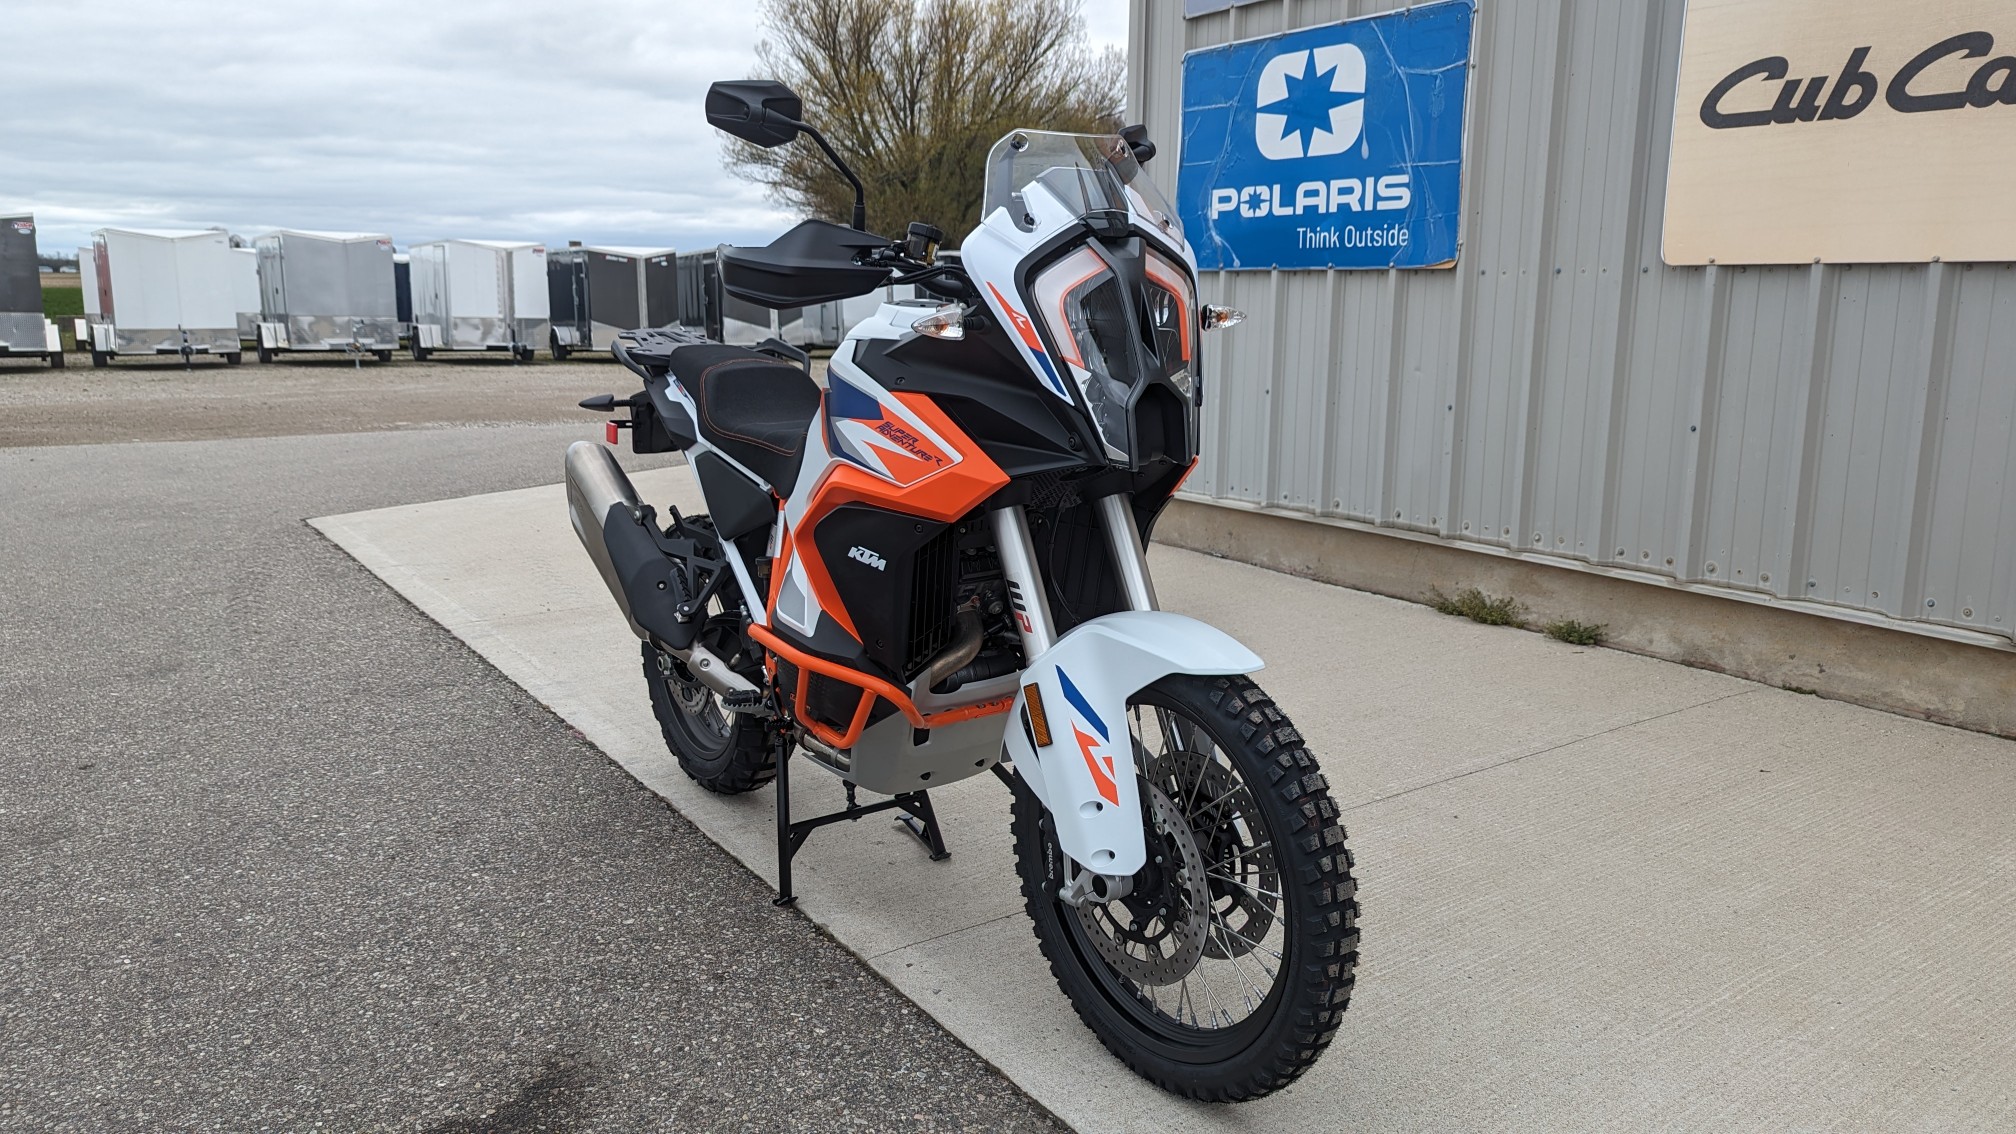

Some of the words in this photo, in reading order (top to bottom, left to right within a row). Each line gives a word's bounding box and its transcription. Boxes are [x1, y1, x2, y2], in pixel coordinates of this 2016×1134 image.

[1700, 56, 1878, 129] Cub
[1211, 174, 1411, 220] POLARIS
[1297, 226, 1340, 249] Think
[1344, 224, 1409, 248] Outside
[875, 425, 933, 462] ADVENTURE
[879, 421, 919, 445] SUPER
[848, 546, 887, 572] KTM
